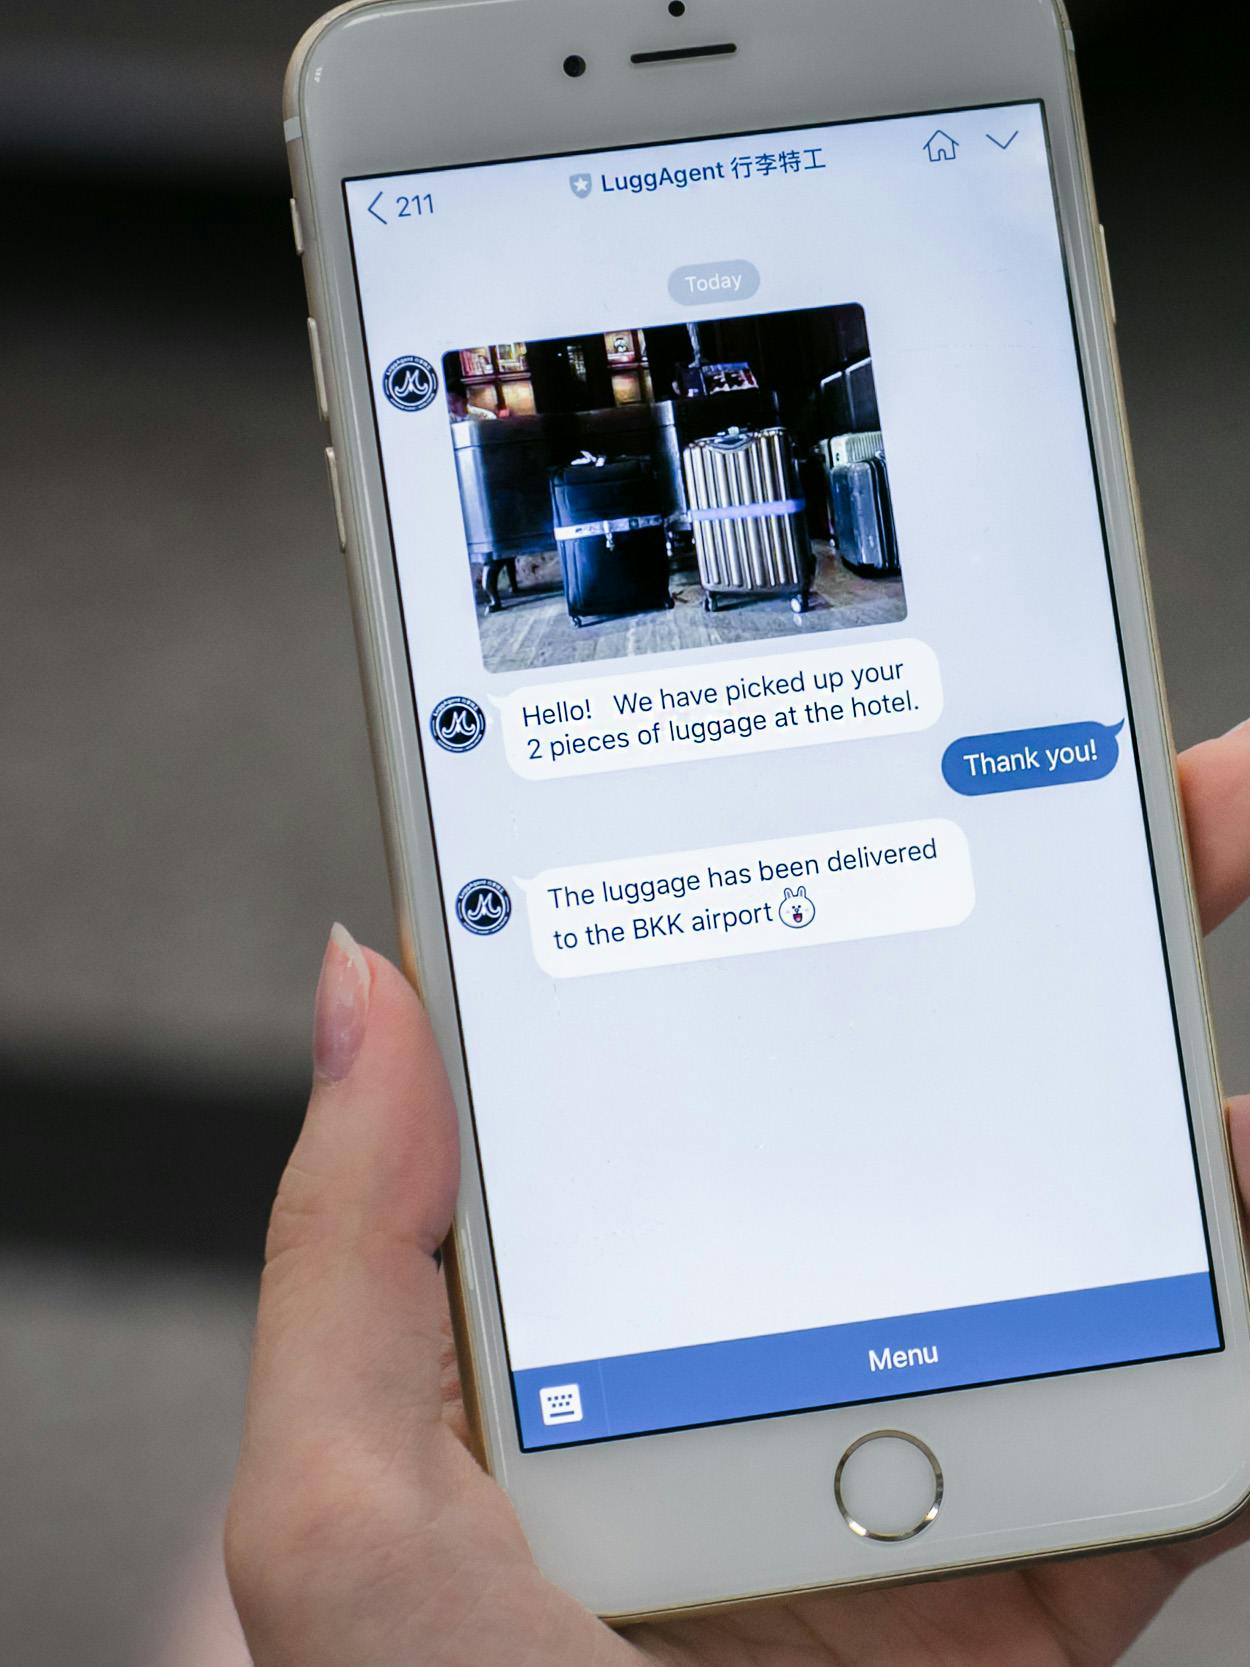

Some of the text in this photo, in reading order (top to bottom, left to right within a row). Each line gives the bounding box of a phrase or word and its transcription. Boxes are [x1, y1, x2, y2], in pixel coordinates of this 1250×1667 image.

[601, 147, 826, 194] LuggAgent 行李特工
[396, 193, 434, 218] 211
[684, 272, 742, 293] Today
[522, 663, 904, 728] Hello! We have picked up your
[527, 689, 919, 762] 2 pieces of luggage at the hotel.
[962, 738, 1098, 776] Thank you!
[547, 837, 937, 909] The luggage has been delivered
[553, 902, 774, 950] to the BKK airport
[868, 1345, 939, 1372] Menu
